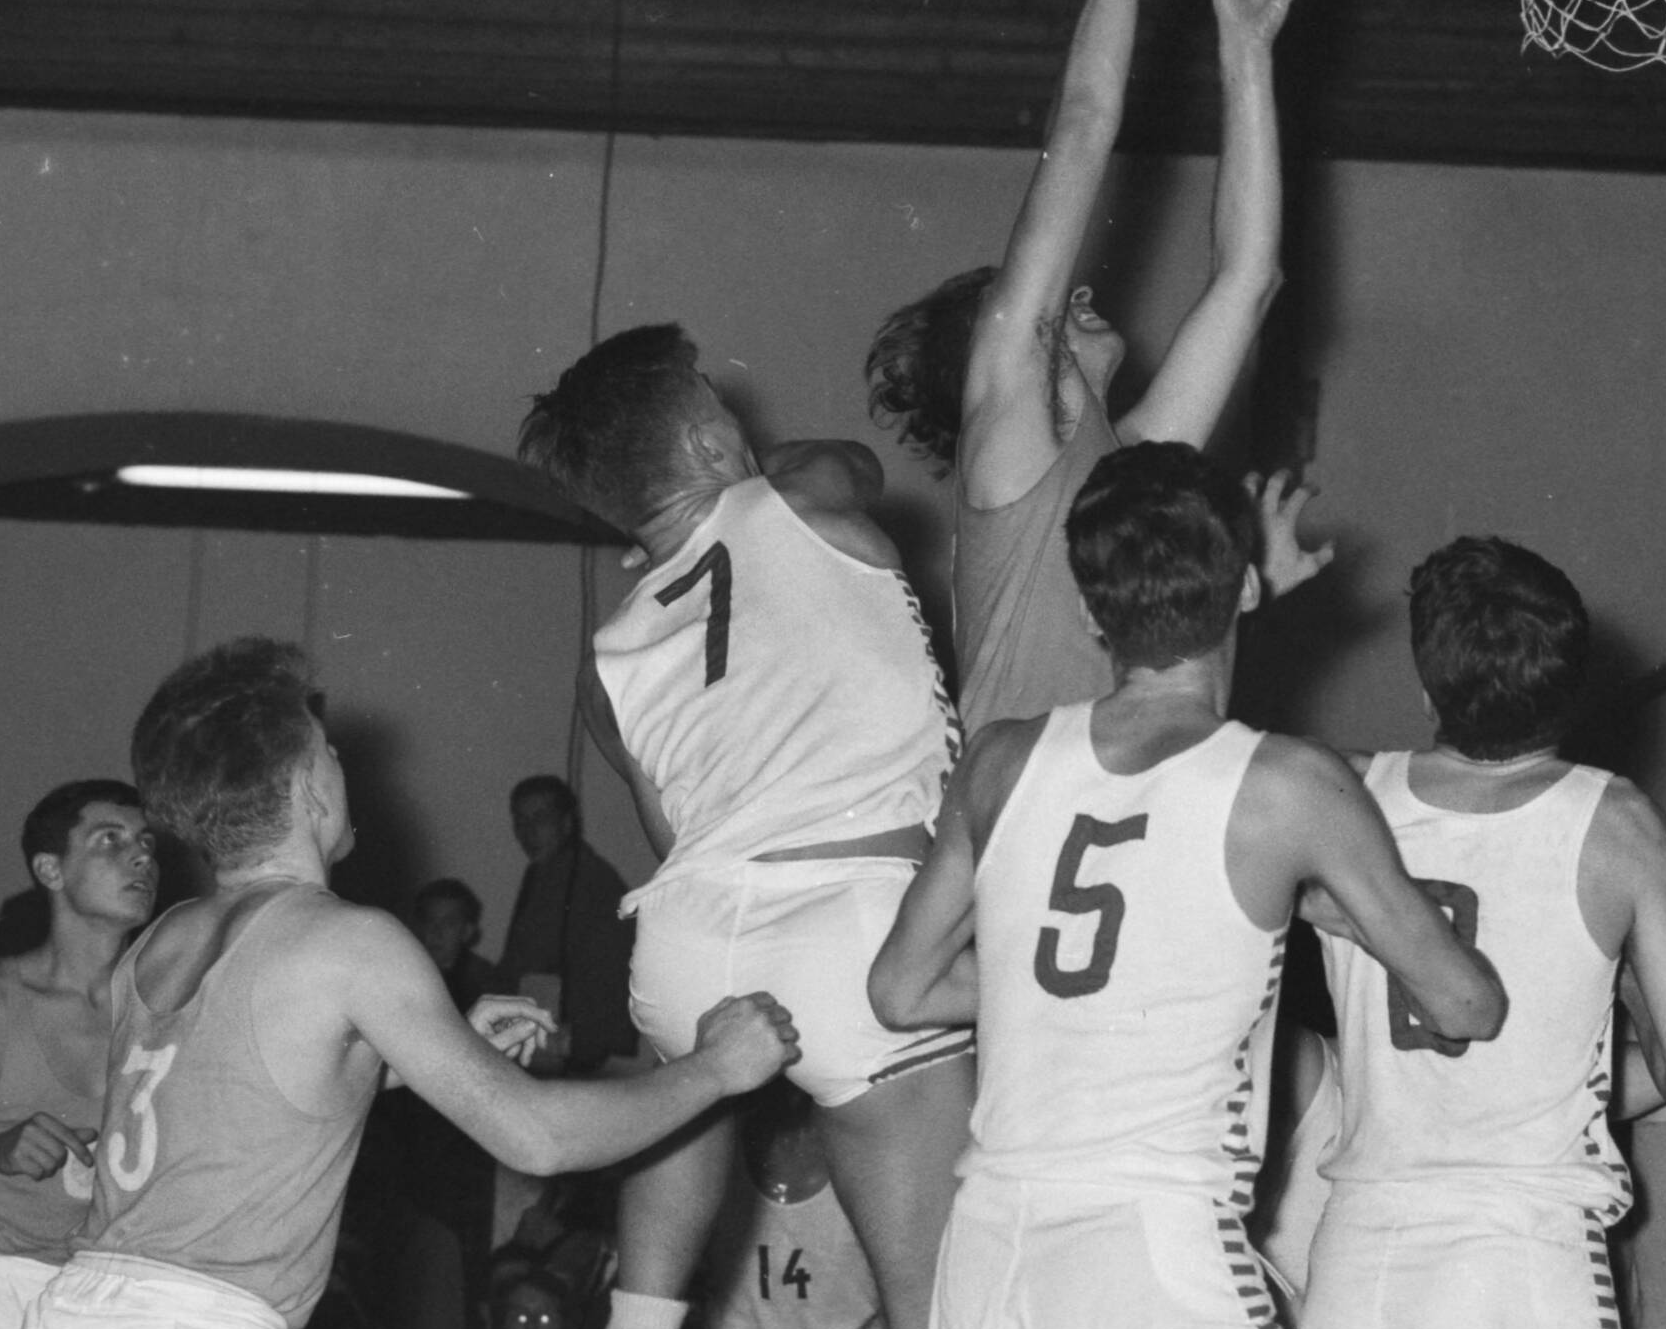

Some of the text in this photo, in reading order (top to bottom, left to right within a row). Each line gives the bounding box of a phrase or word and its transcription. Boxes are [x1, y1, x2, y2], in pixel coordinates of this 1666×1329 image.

[1034, 812, 1148, 999] 5
[108, 1044, 177, 1192] 3
[757, 1244, 812, 1301] 14
